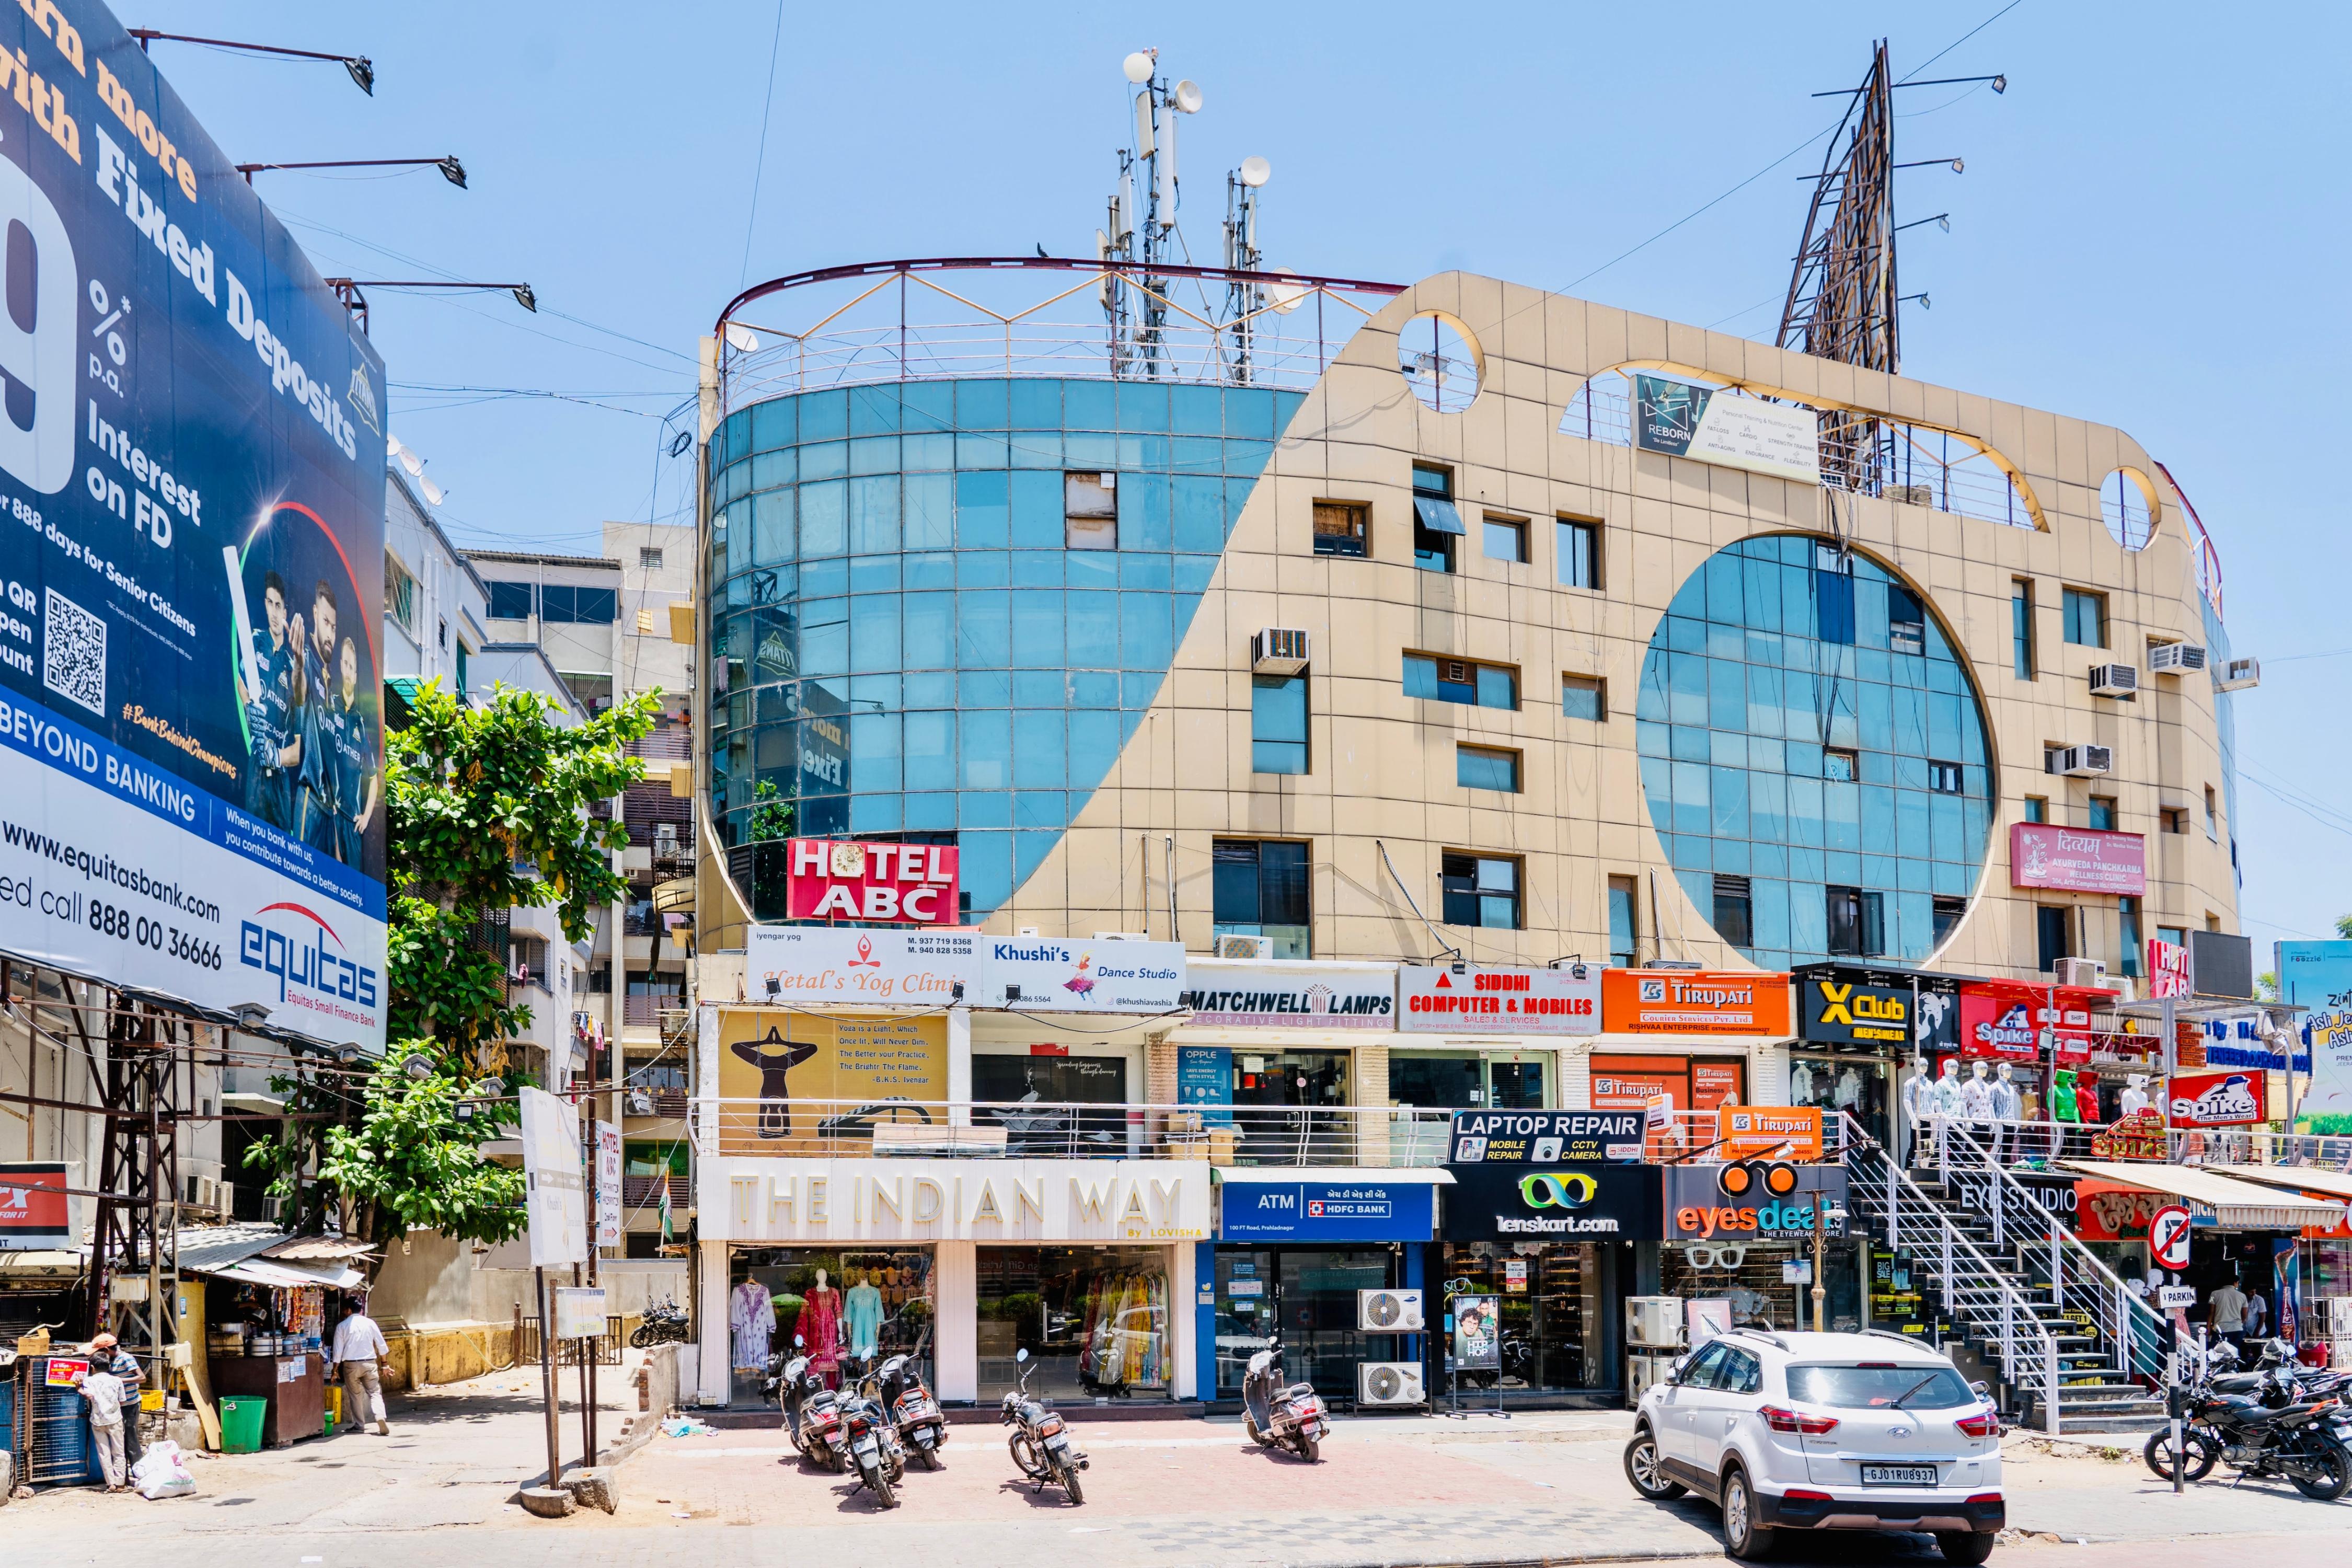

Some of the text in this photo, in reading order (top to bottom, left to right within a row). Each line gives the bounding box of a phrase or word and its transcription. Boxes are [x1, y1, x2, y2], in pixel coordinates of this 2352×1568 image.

[96, 57, 197, 203] more
[96, 123, 356, 461] Fixed Deposits
[1648, 424, 1691, 441] REBORN
[1707, 426, 1815, 452] FAT-LOSS CARDIO STRENGTH TRAINING
[89, 398, 201, 527] Interest
[1708, 443, 1811, 467] ANTI-AGING ENDURANCE FLEXIBILITY
[87, 466, 172, 548] on FD
[13, 498, 42, 532] 888
[45, 523, 81, 559] days
[84, 546, 103, 572] for
[106, 561, 147, 603] Senior
[149, 592, 196, 637] Citizens
[267, 689, 286, 713] ATHER
[122, 702, 237, 780] #BankBehindChampions
[0, 700, 195, 822] BEYOND BANKING
[226, 807, 314, 865] When you bank with us,
[2057, 829, 2101, 860] दिव्यम्
[3, 820, 220, 924] www.equitasbank.com
[226, 831, 363, 906] you contribute towards a better society.
[2053, 858, 2141, 874] AYURVEDA PANCHKARMA
[2069, 870, 2126, 882] WELLNESS CLINIC
[811, 884, 938, 920] ABC
[41, 890, 221, 971] call 888 00 36666
[756, 932, 785, 941] iyengar
[240, 920, 375, 1008] equitas
[995, 944, 1070, 962] Khushi's
[1098, 966, 1177, 979] Dance Studio
[1474, 974, 1530, 991] SIDDHI
[853, 971, 895, 997] Yog
[288, 989, 375, 1028] Equitas Small Finance Bank
[1116, 998, 1172, 1006] @khushiavashia
[1190, 991, 1391, 1014] MATCHWELL LAMPS
[1410, 995, 1593, 1015] COMPUTER & MOBILES
[1818, 981, 1905, 1024] X Club
[839, 1024, 856, 1033] Yoga
[873, 1025, 894, 1034] Light,
[1282, 1017, 1392, 1027] LIGHT FITTINGS
[1853, 1027, 1905, 1041] MEN'S WEAR
[1976, 1022, 2033, 1045] Spike
[1186, 1050, 1217, 1059] OPPLE
[903, 1076, 929, 1085] Iyengar
[2171, 1099, 2256, 1121] Spike
[1457, 1115, 1637, 1135] LAPTOP REPAIR
[1486, 1151, 1602, 1160] REPAIR CAMERA
[1489, 1140, 1598, 1149] MOBILE CCTV
[730, 1175, 1183, 1224] THE INDIAN WAY
[1258, 1195, 1295, 1209] ATM
[1327, 1190, 1341, 1198] એચ
[1342, 1190, 1350, 1198] ડી
[1365, 1190, 1374, 1198] સી
[2007, 1186, 2078, 1212] STUDIO
[1327, 1205, 1386, 1214] HDFC BANK
[1127, 1228, 1203, 1239] By LOVISHA
[1496, 1216, 1619, 1232] lenskart.com
[1871, 1469, 1933, 1480] GJ01RU8937
